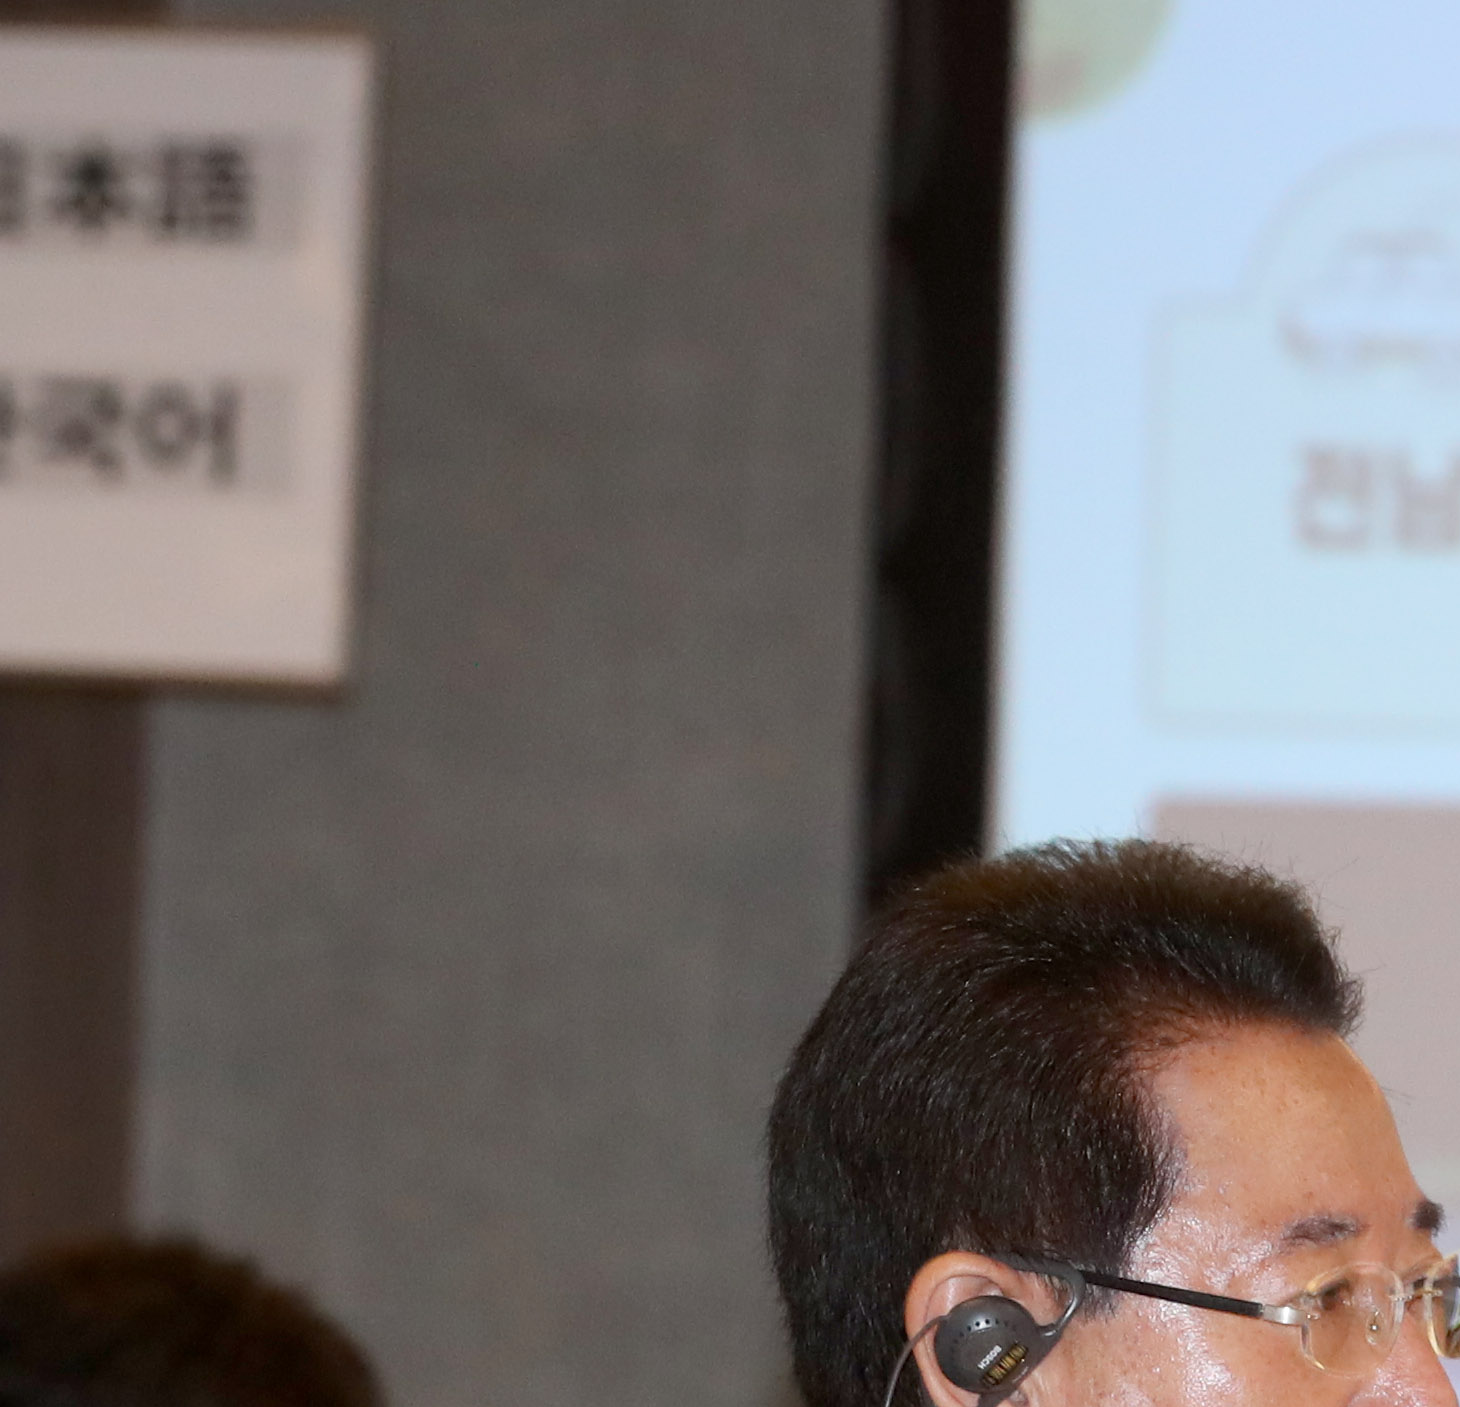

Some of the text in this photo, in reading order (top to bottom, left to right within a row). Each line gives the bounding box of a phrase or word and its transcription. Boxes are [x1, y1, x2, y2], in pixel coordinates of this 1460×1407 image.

[0, 135, 256, 242] 本語
[0, 370, 242, 488] 국어
[977, 1345, 1002, 1370] BOSCH
